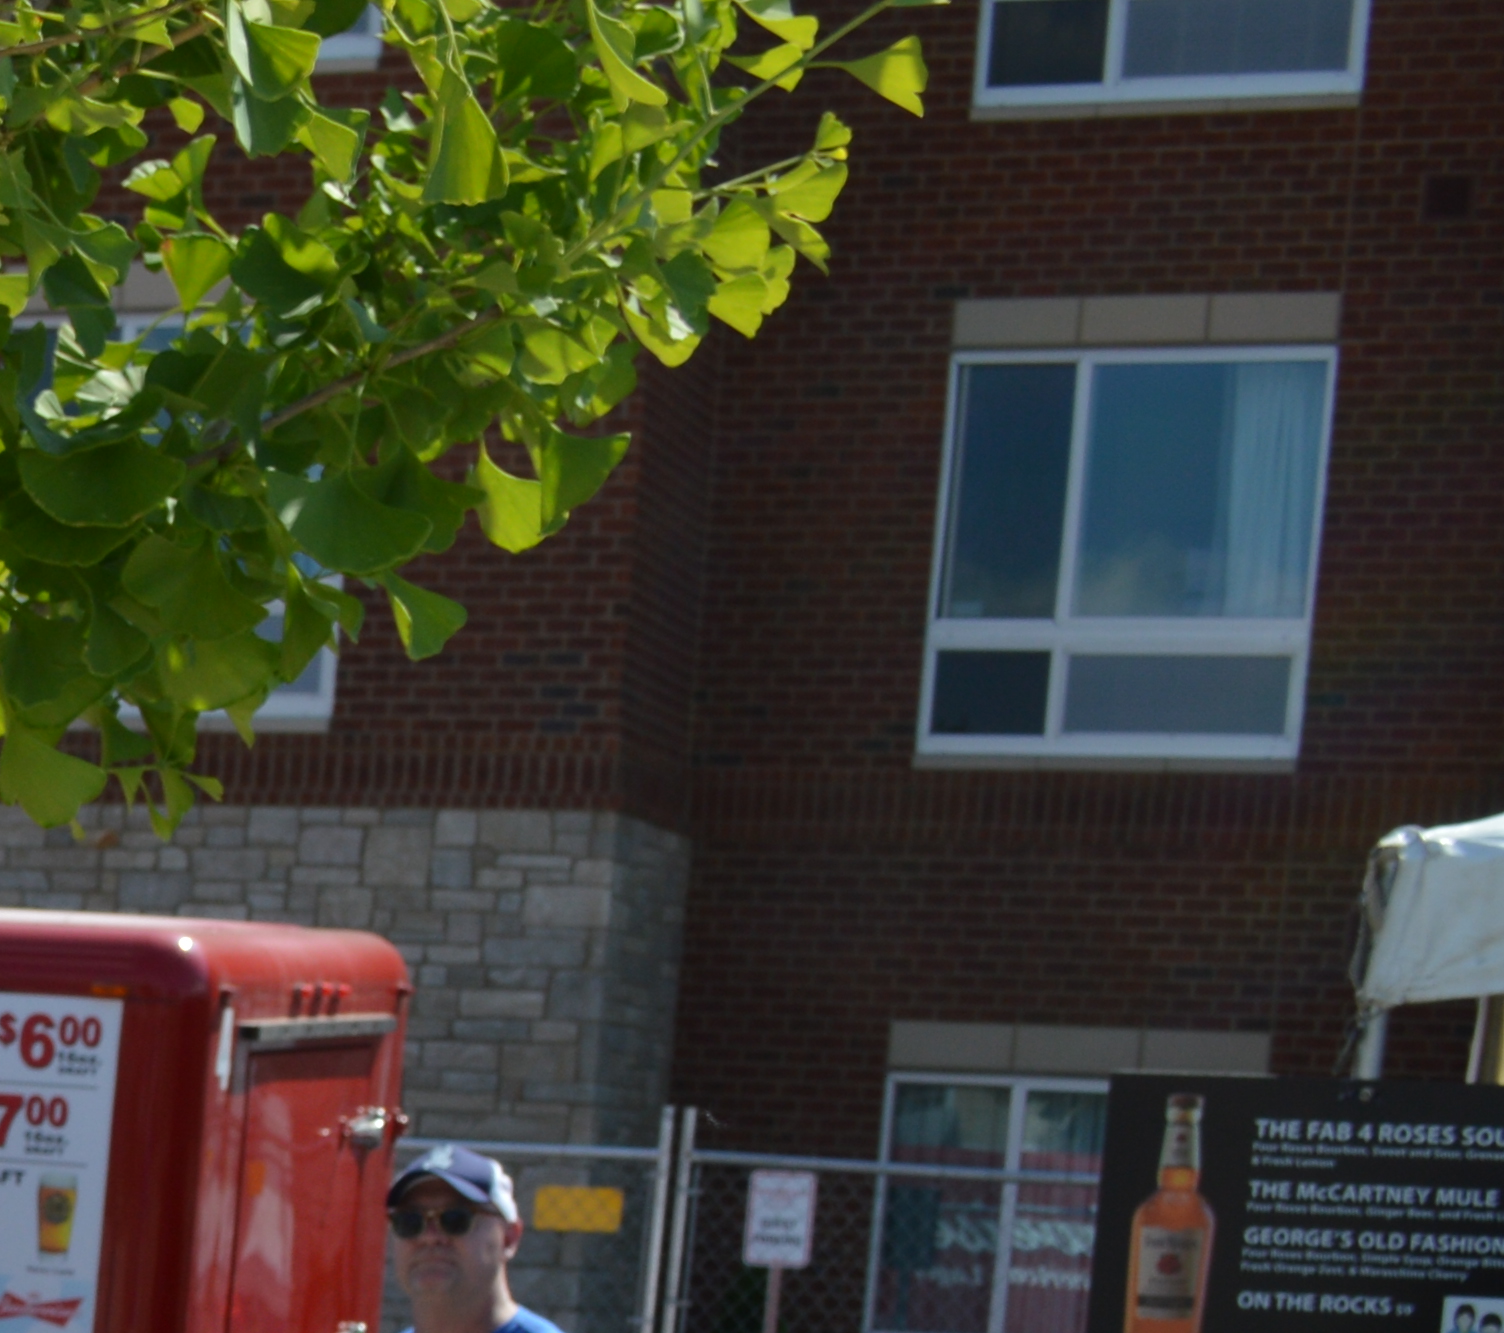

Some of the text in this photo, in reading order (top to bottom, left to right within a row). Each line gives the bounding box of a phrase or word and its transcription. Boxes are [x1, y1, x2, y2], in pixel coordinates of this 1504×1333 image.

[1254, 1118, 1302, 1140] THE
[1306, 1120, 1354, 1141] FAB
[1357, 1122, 1374, 1143] 4
[1378, 1123, 1457, 1145] ROSES
[1249, 1180, 1501, 1208] THE McCARTNEY MULE
[1243, 1226, 1354, 1249] GEORGE'S
[1358, 1231, 1406, 1250] OLD
[1237, 1290, 1271, 1310] ON
[1275, 1292, 1316, 1312] THE
[1320, 1293, 1391, 1316] ROCKS
